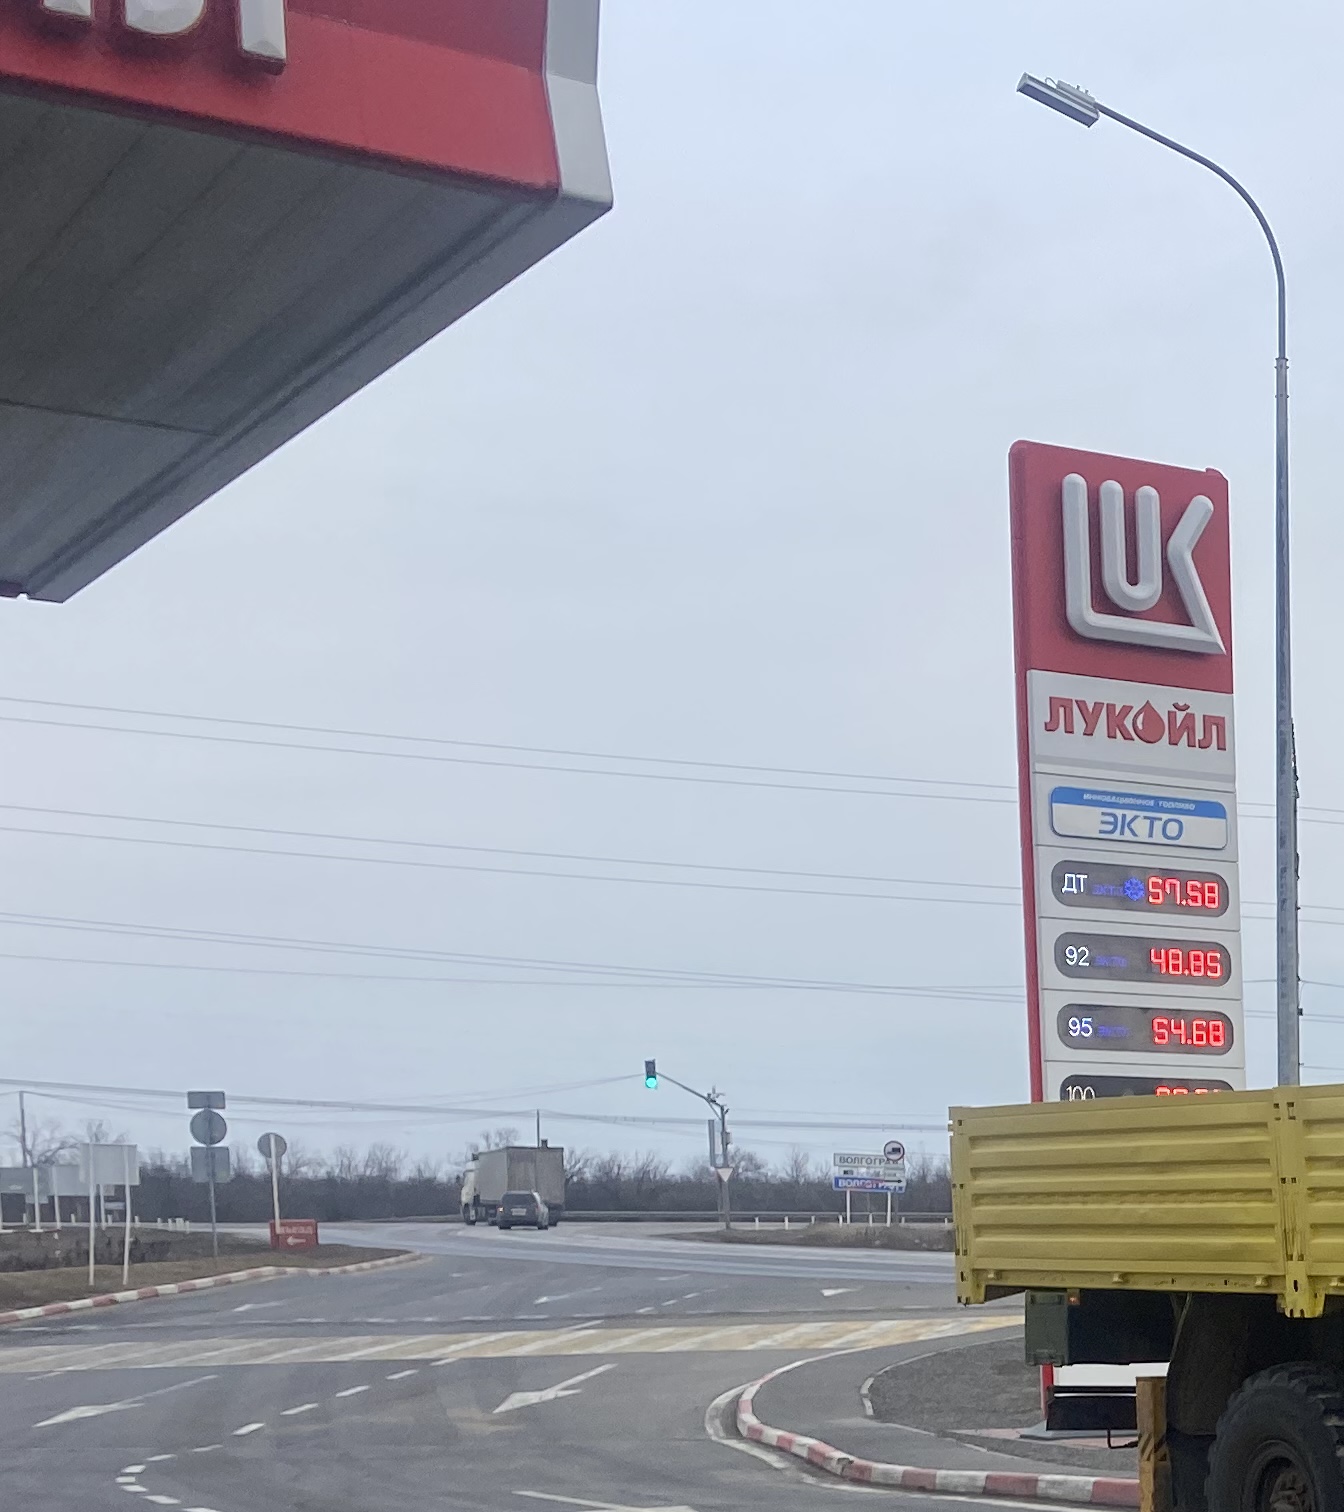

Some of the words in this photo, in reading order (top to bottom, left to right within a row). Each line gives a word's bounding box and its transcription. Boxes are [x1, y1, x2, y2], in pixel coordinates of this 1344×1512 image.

[1044, 696, 1227, 751] ЛУКОЙЛ
[1099, 811, 1184, 841] ЭКТО
[1062, 873, 1088, 894] ДТ
[1148, 876, 1220, 909] 57.58
[1065, 945, 1090, 967] 92
[1068, 1016, 1093, 1037] 95
